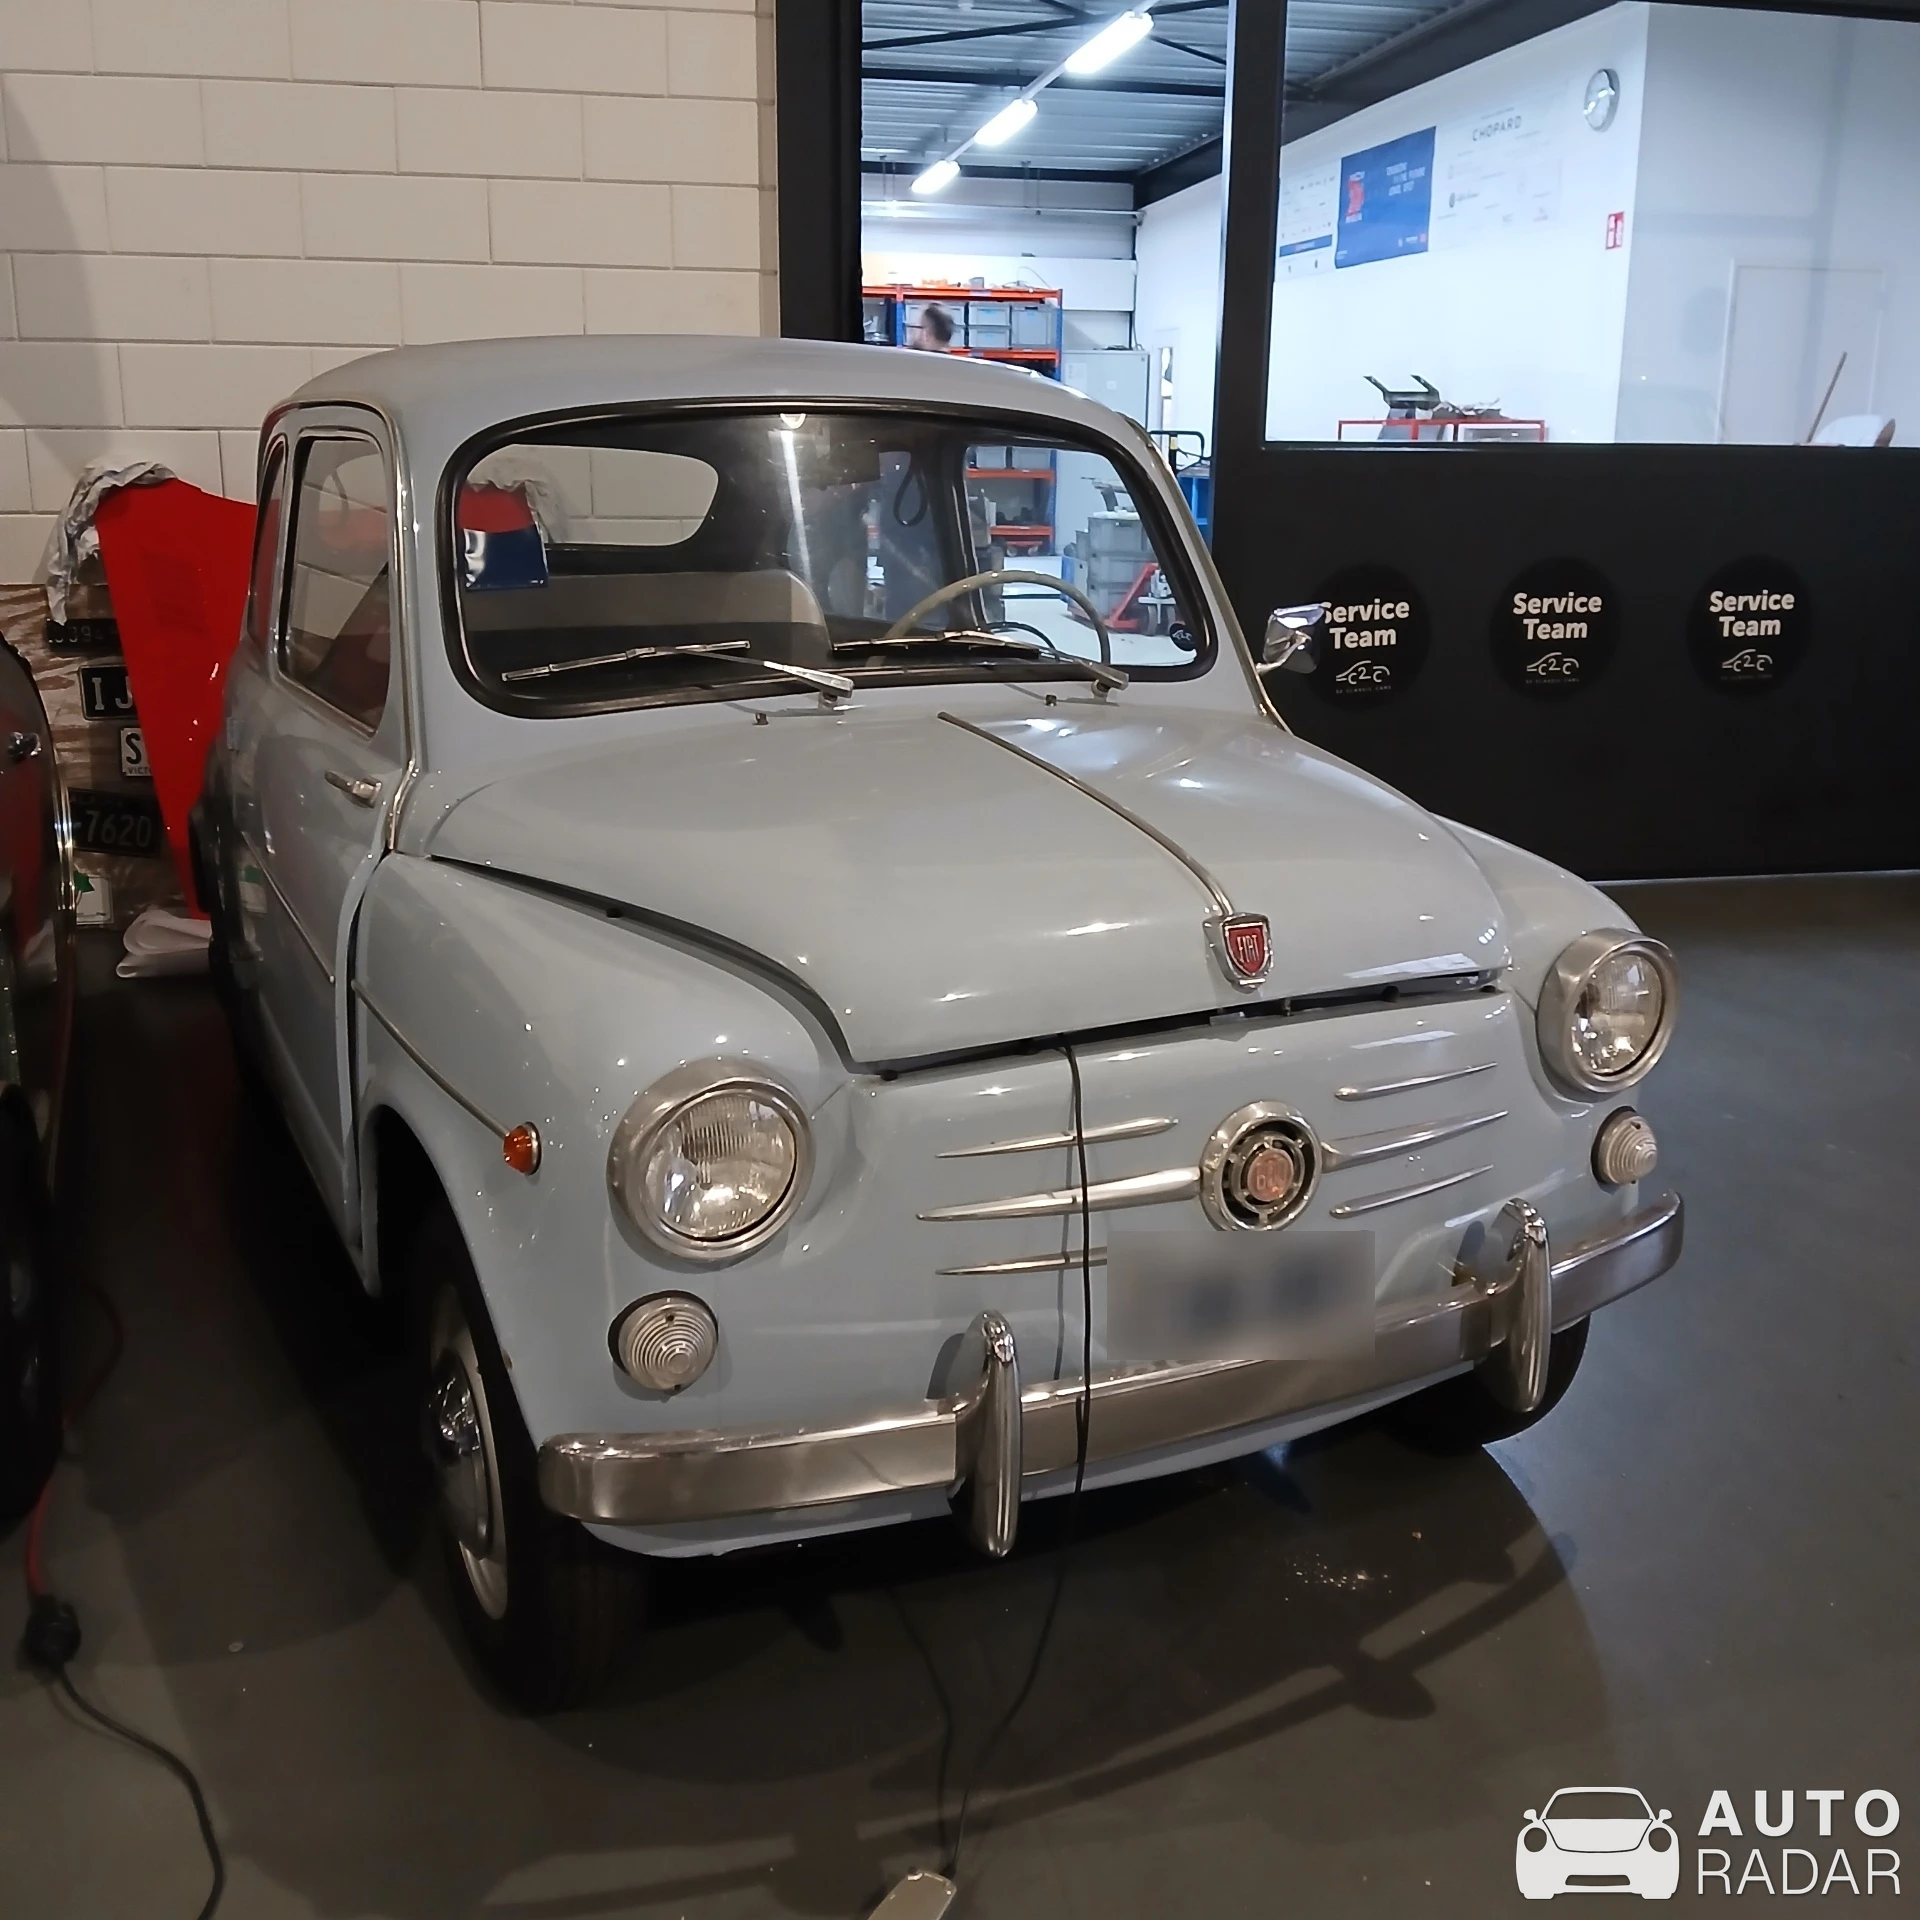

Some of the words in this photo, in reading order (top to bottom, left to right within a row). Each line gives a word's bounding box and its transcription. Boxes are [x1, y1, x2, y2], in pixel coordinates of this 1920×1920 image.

[1472, 115, 1522, 141] CHOPARD
[1512, 591, 1603, 615] Service
[1709, 589, 1795, 613] Service
[1522, 618, 1588, 640] Team
[1718, 615, 1781, 637] Team
[1329, 627, 1397, 650] Team
[125, 733, 142, 765] S
[1236, 934, 1260, 963] FIAT
